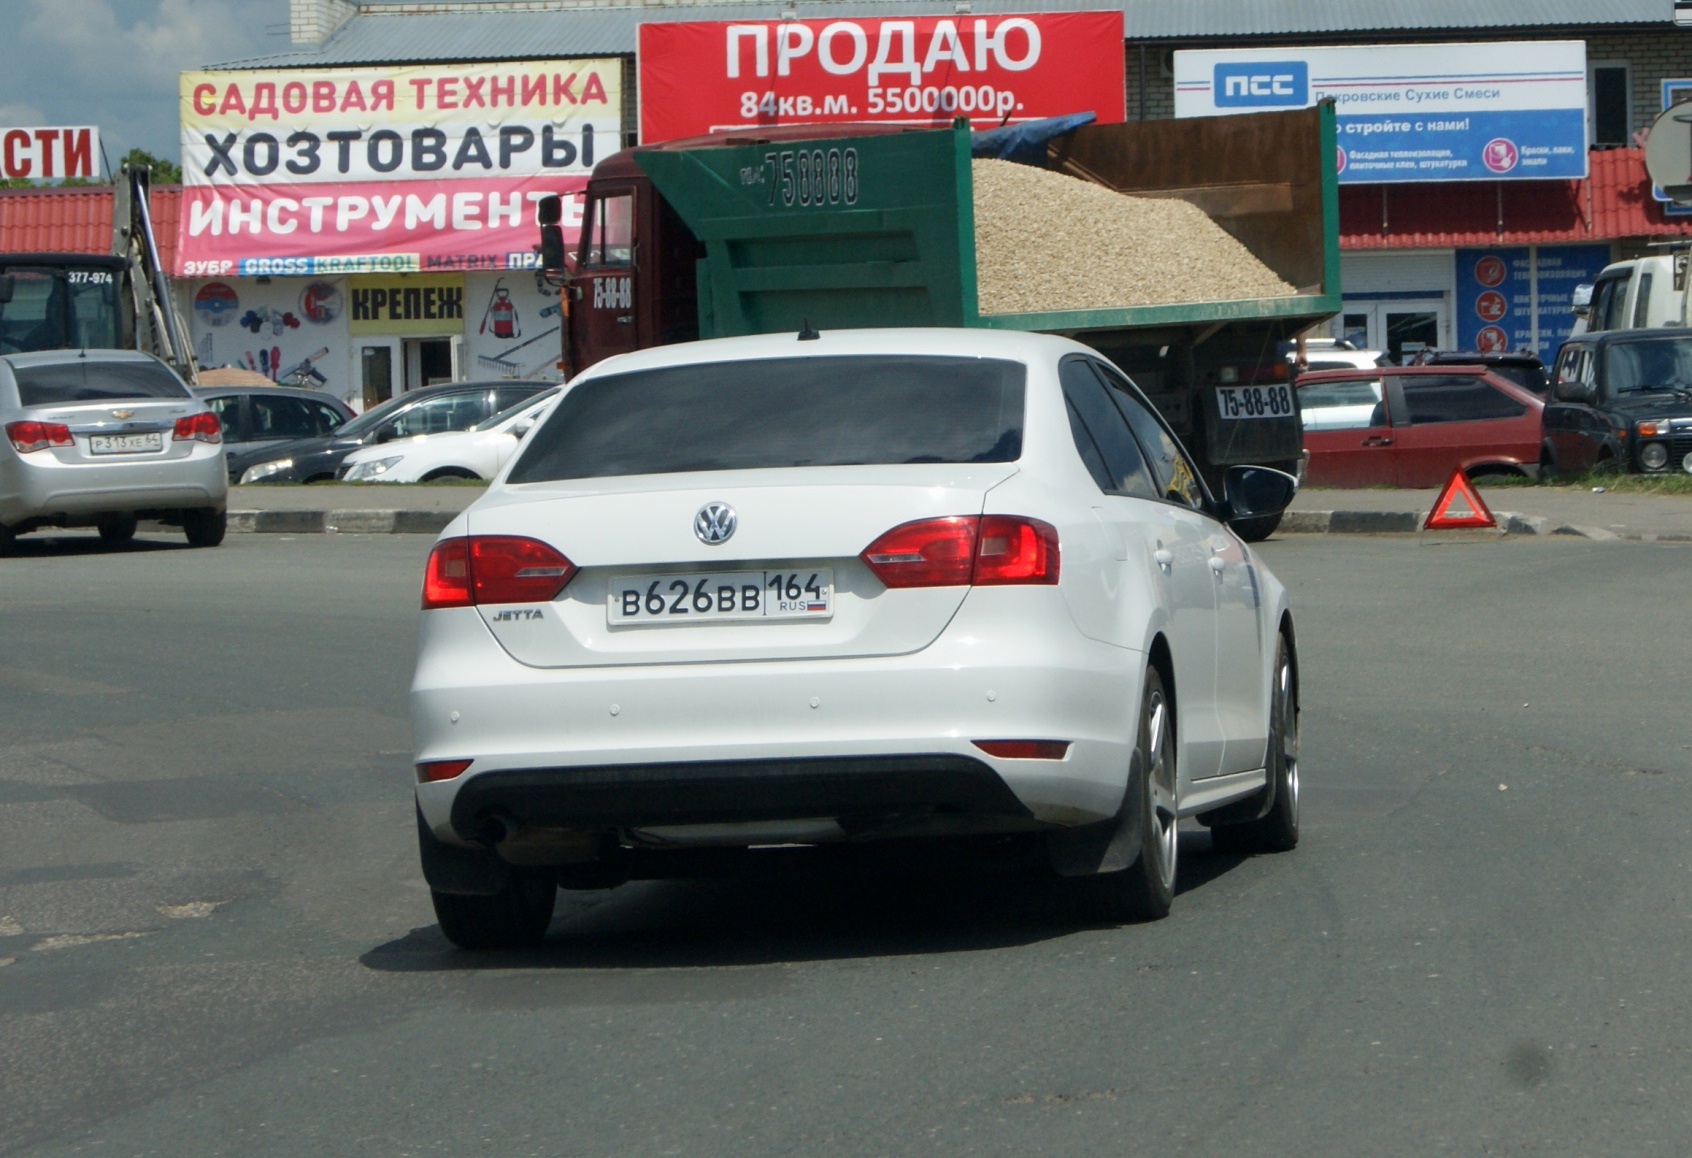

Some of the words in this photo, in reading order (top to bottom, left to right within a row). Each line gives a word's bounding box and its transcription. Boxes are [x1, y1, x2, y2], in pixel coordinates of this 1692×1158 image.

[727, 18, 1042, 87] ПРОДАЮ
[193, 80, 395, 120] САДОВАЯ
[409, 72, 608, 110] ТЕХНИКА
[1225, 74, 1294, 96] ПСС
[1405, 88, 1449, 105] Сухие
[1454, 87, 1500, 99] Смеси
[740, 91, 858, 118] 84кв.м.
[867, 85, 1024, 116] 5500000р.
[1345, 120, 1411, 136] стройте
[1415, 122, 1424, 131] с
[1427, 118, 1470, 131] нами!
[0, 129, 92, 178] СТИ
[204, 123, 594, 177] ХОЗТОВАРЫ
[765, 147, 859, 207] 758888
[183, 259, 234, 275] ЗУБР
[245, 257, 309, 274] GROSS
[316, 255, 417, 271] KRAFTOOL
[427, 253, 498, 269] MATRIX
[68, 271, 113, 284] 377-974
[352, 286, 464, 320] КРЕПЕЖ
[592, 277, 632, 309] 75-88-88
[1220, 386, 1290, 417] 75-88-88
[768, 574, 821, 601] 164
[493, 609, 544, 622] JETTA
[779, 601, 806, 611] RUS
